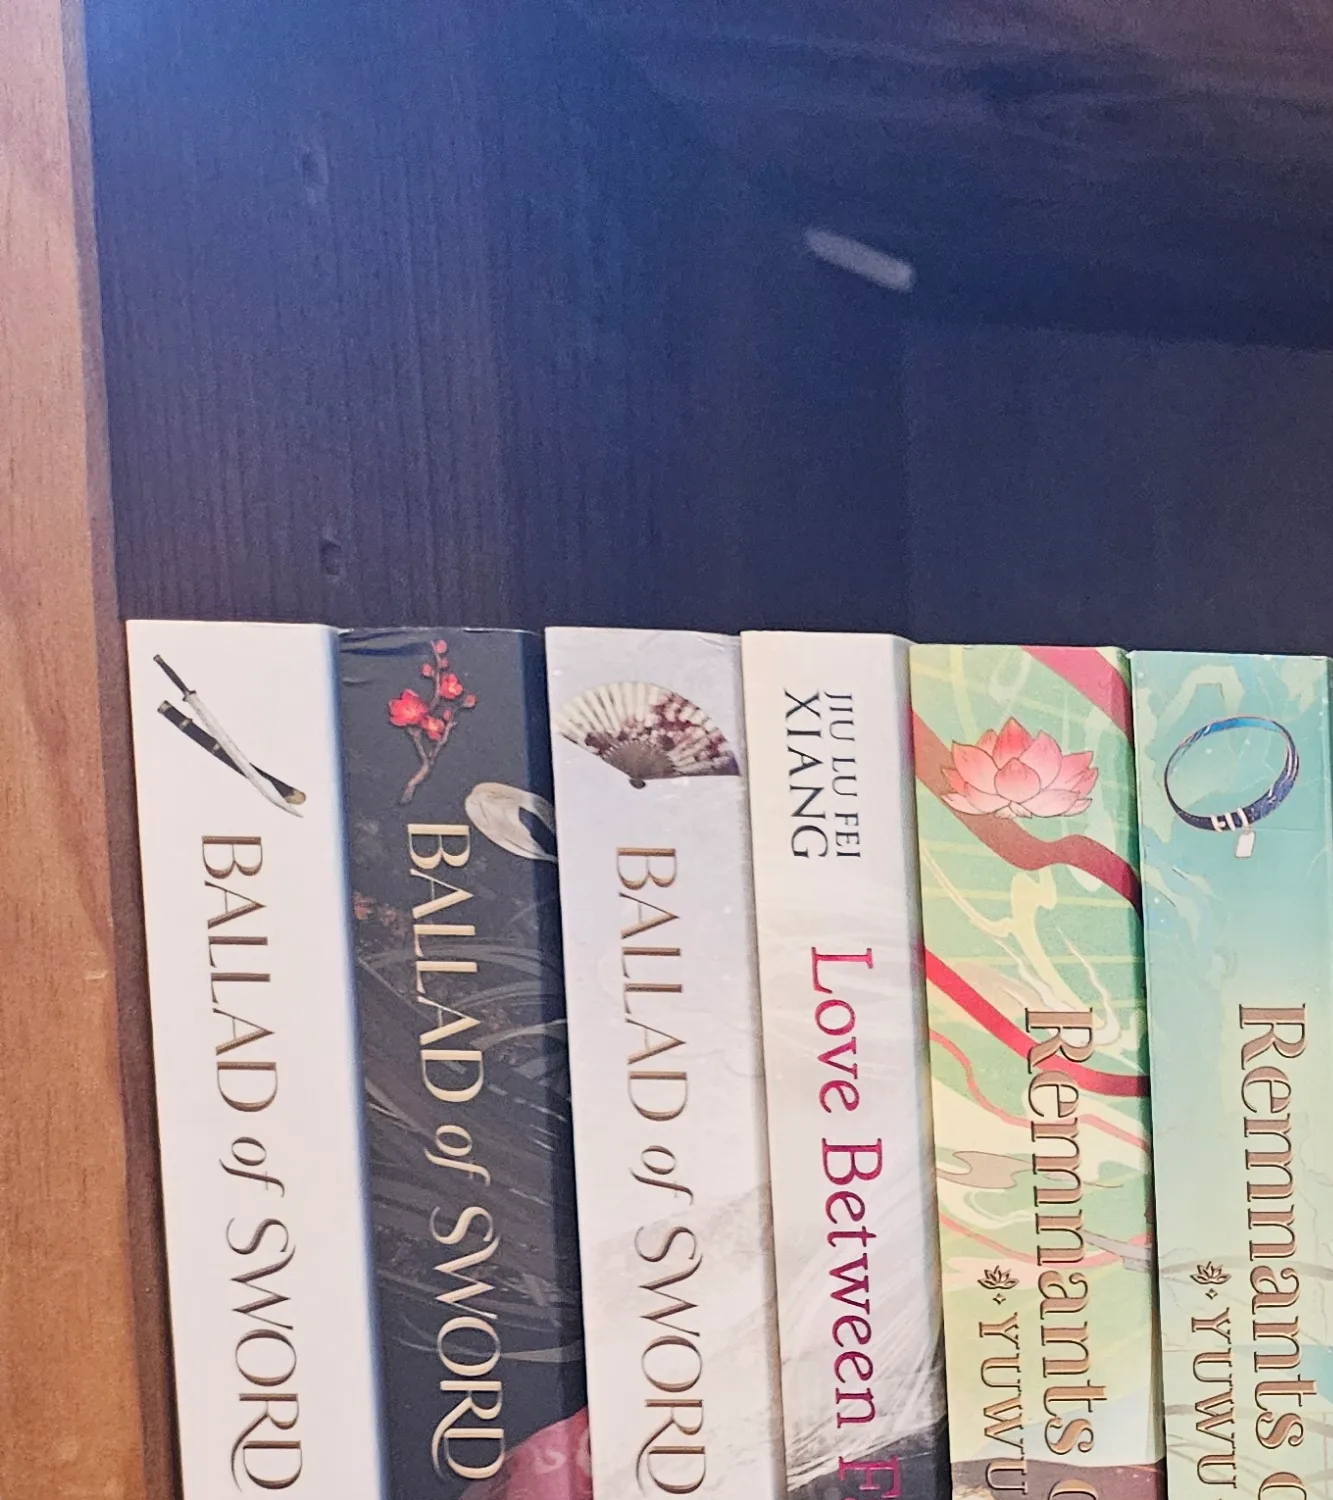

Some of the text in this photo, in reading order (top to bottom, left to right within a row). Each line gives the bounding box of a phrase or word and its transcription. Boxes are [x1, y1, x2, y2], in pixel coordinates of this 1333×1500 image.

[784, 687, 828, 858] XIANG
[824, 691, 861, 858] JIU LU FEI
[201, 834, 278, 1113] BALLAD
[408, 823, 484, 1103] BALLAD
[617, 847, 688, 1122] BALLAD
[812, 946, 874, 1113] Love
[220, 1137, 285, 1198] of
[425, 1125, 490, 1187] of
[631, 1146, 694, 1205] of
[820, 1138, 883, 1429] Between
[1025, 1007, 1107, 1454] Remnants
[1239, 1003, 1317, 1449] Remnants
[226, 1217, 303, 1492] SWORD
[432, 1206, 507, 1481] SWORD
[635, 1225, 708, 1496] SWORD
[979, 1312, 1028, 1494] YUWU
